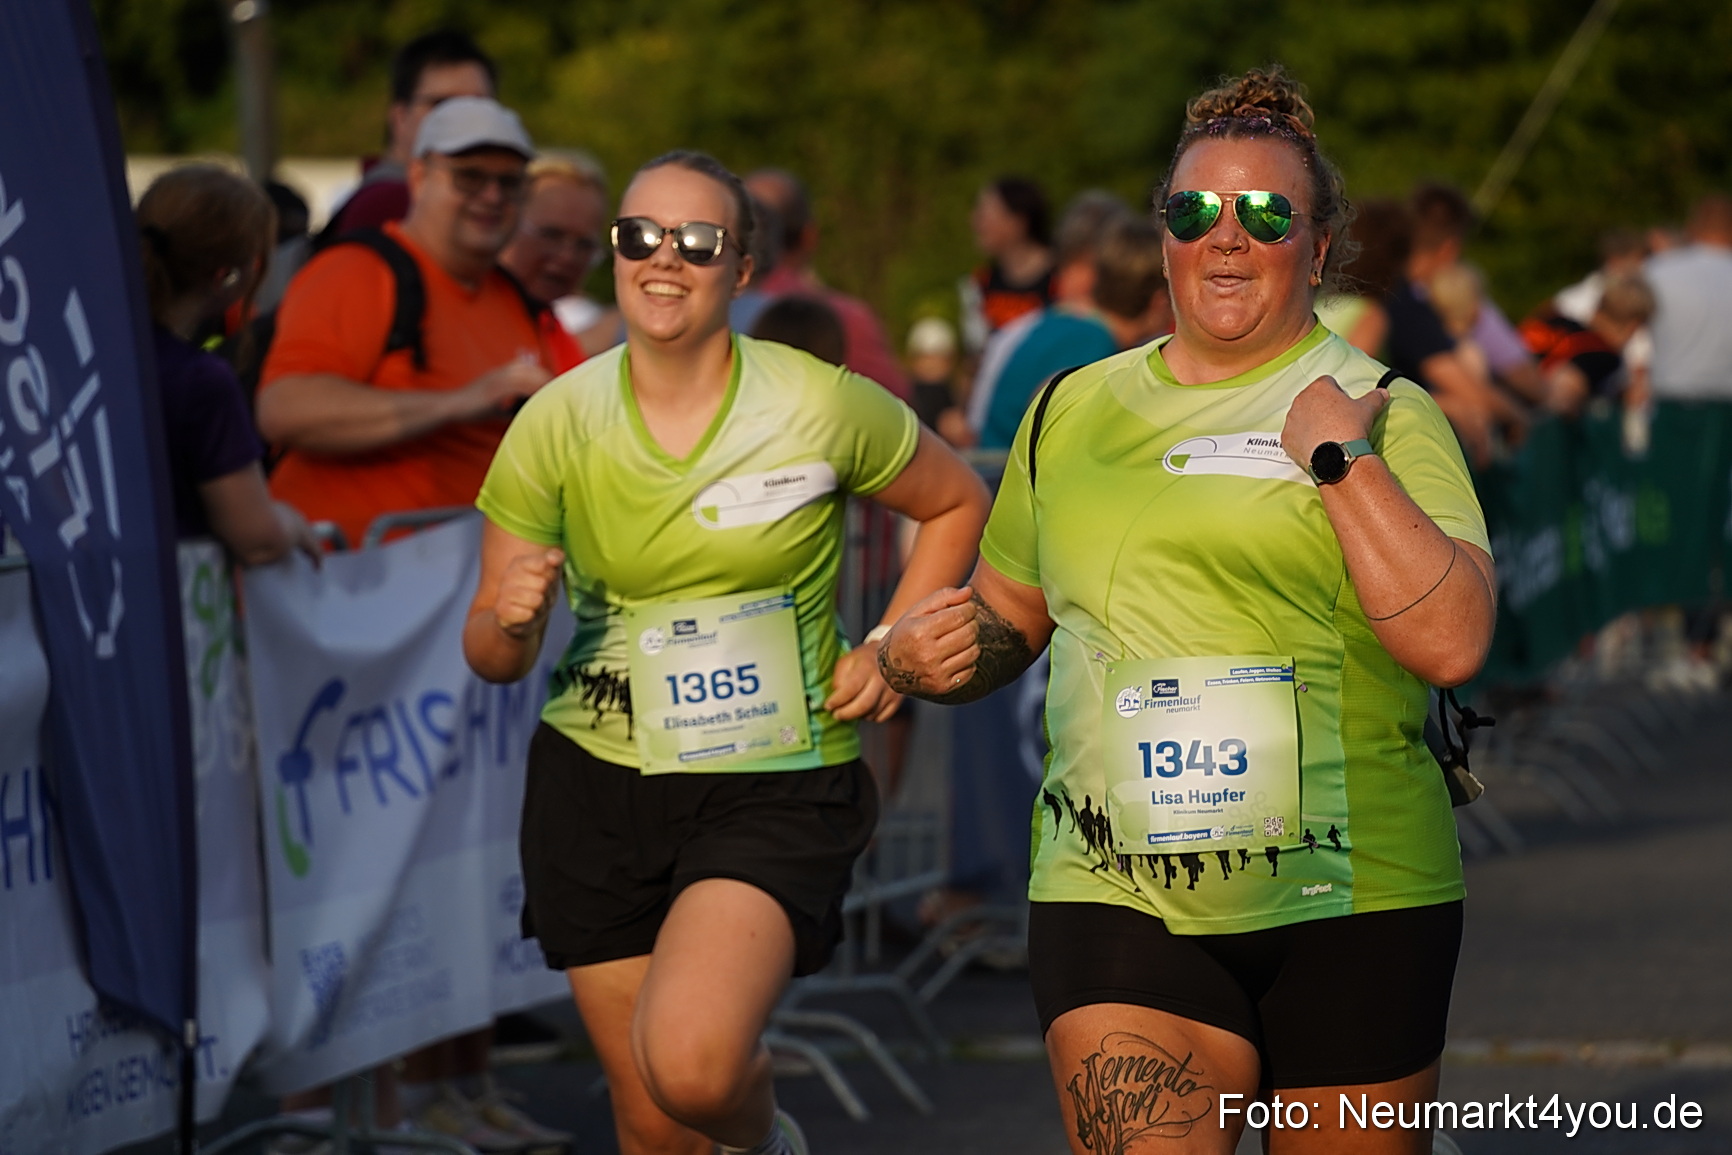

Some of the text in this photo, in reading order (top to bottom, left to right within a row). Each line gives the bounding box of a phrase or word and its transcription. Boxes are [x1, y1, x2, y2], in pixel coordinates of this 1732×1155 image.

[666, 664, 760, 705] 1365
[1144, 695, 1201, 709] Firmenlauf
[1166, 705, 1200, 714] neumarkt
[664, 711, 733, 730] Elisabeth
[1137, 738, 1248, 779] 1343
[1151, 788, 1246, 807] Lisa Hupfer
[1149, 831, 1209, 844] firmenlauf.bayern
